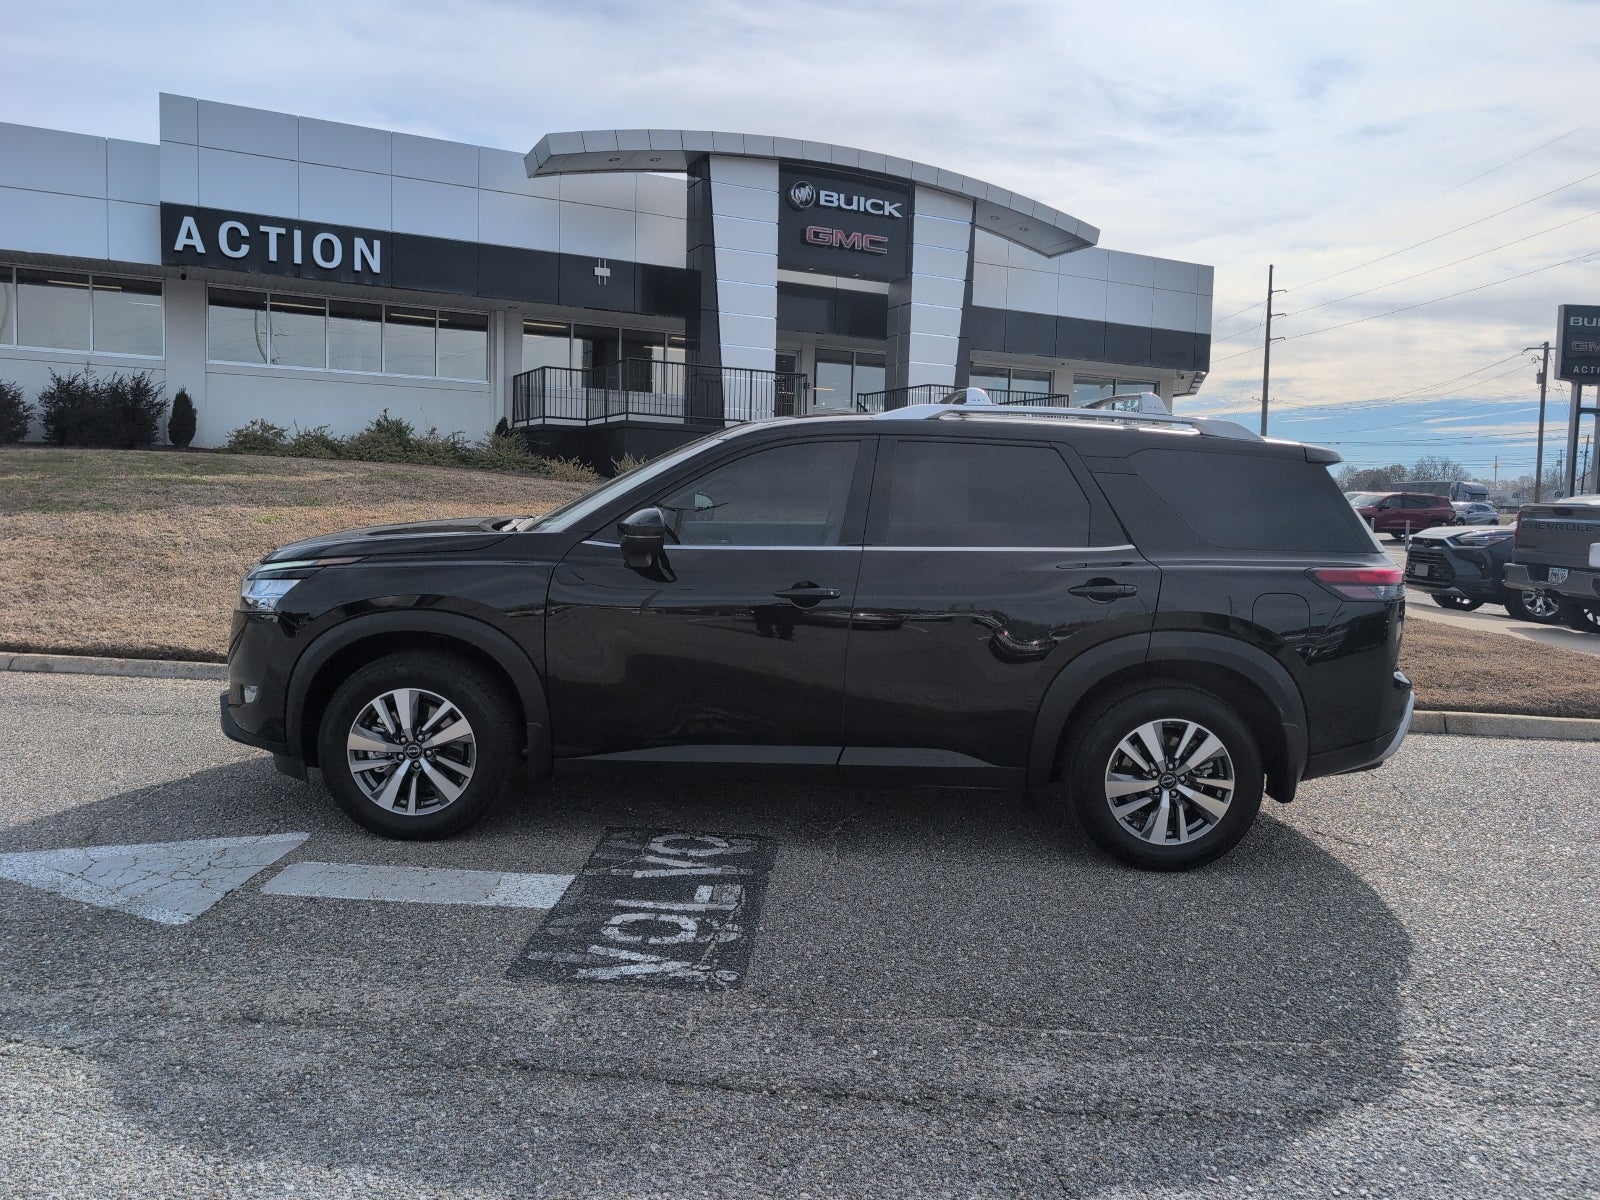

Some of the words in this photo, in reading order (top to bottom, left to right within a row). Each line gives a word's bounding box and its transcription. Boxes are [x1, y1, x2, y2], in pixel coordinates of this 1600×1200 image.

[819, 190, 903, 218] BUICK
[173, 216, 381, 274] ACTION
[806, 225, 888, 254] GMC
[577, 833, 740, 980] VOLVO
